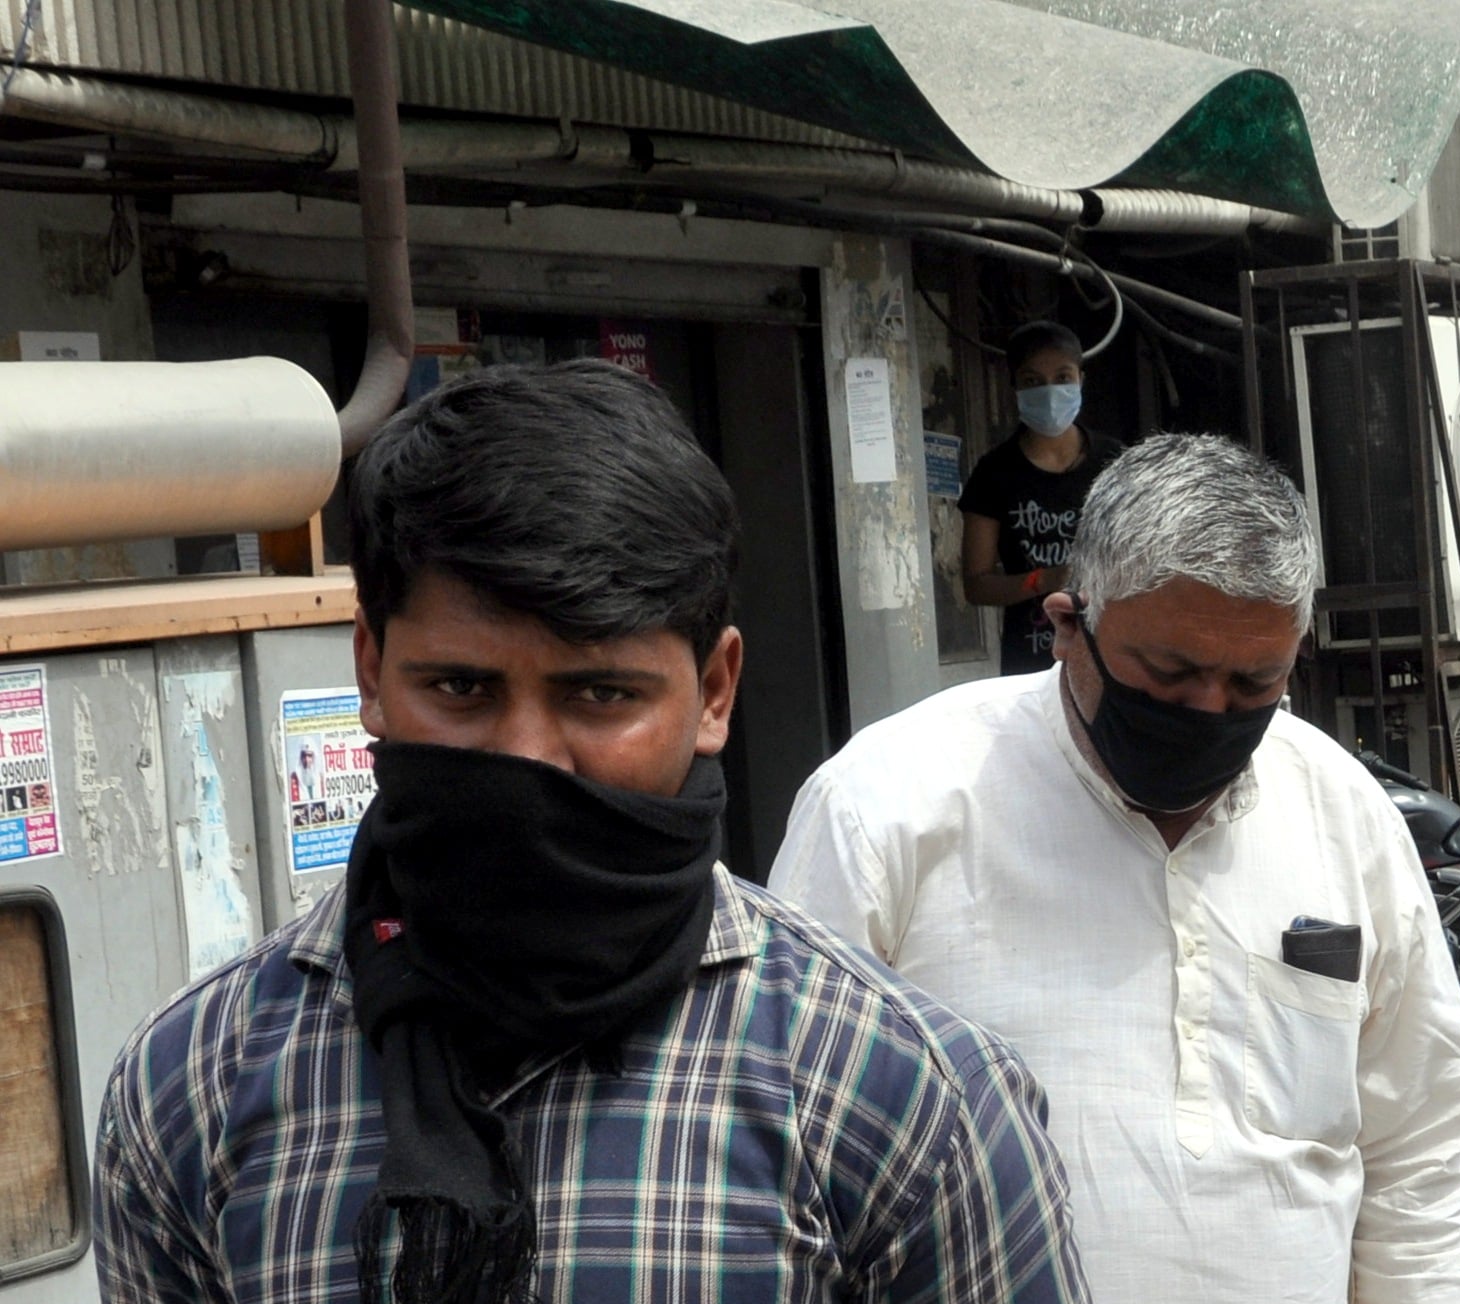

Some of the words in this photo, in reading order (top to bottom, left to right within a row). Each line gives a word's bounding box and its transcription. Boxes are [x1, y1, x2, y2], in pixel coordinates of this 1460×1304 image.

[610, 333, 645, 349] YONO
[612, 355, 646, 369] CASH
[1008, 500, 1077, 538] there
[0, 757, 48, 790] 9980000
[325, 772, 379, 800] 99978004
